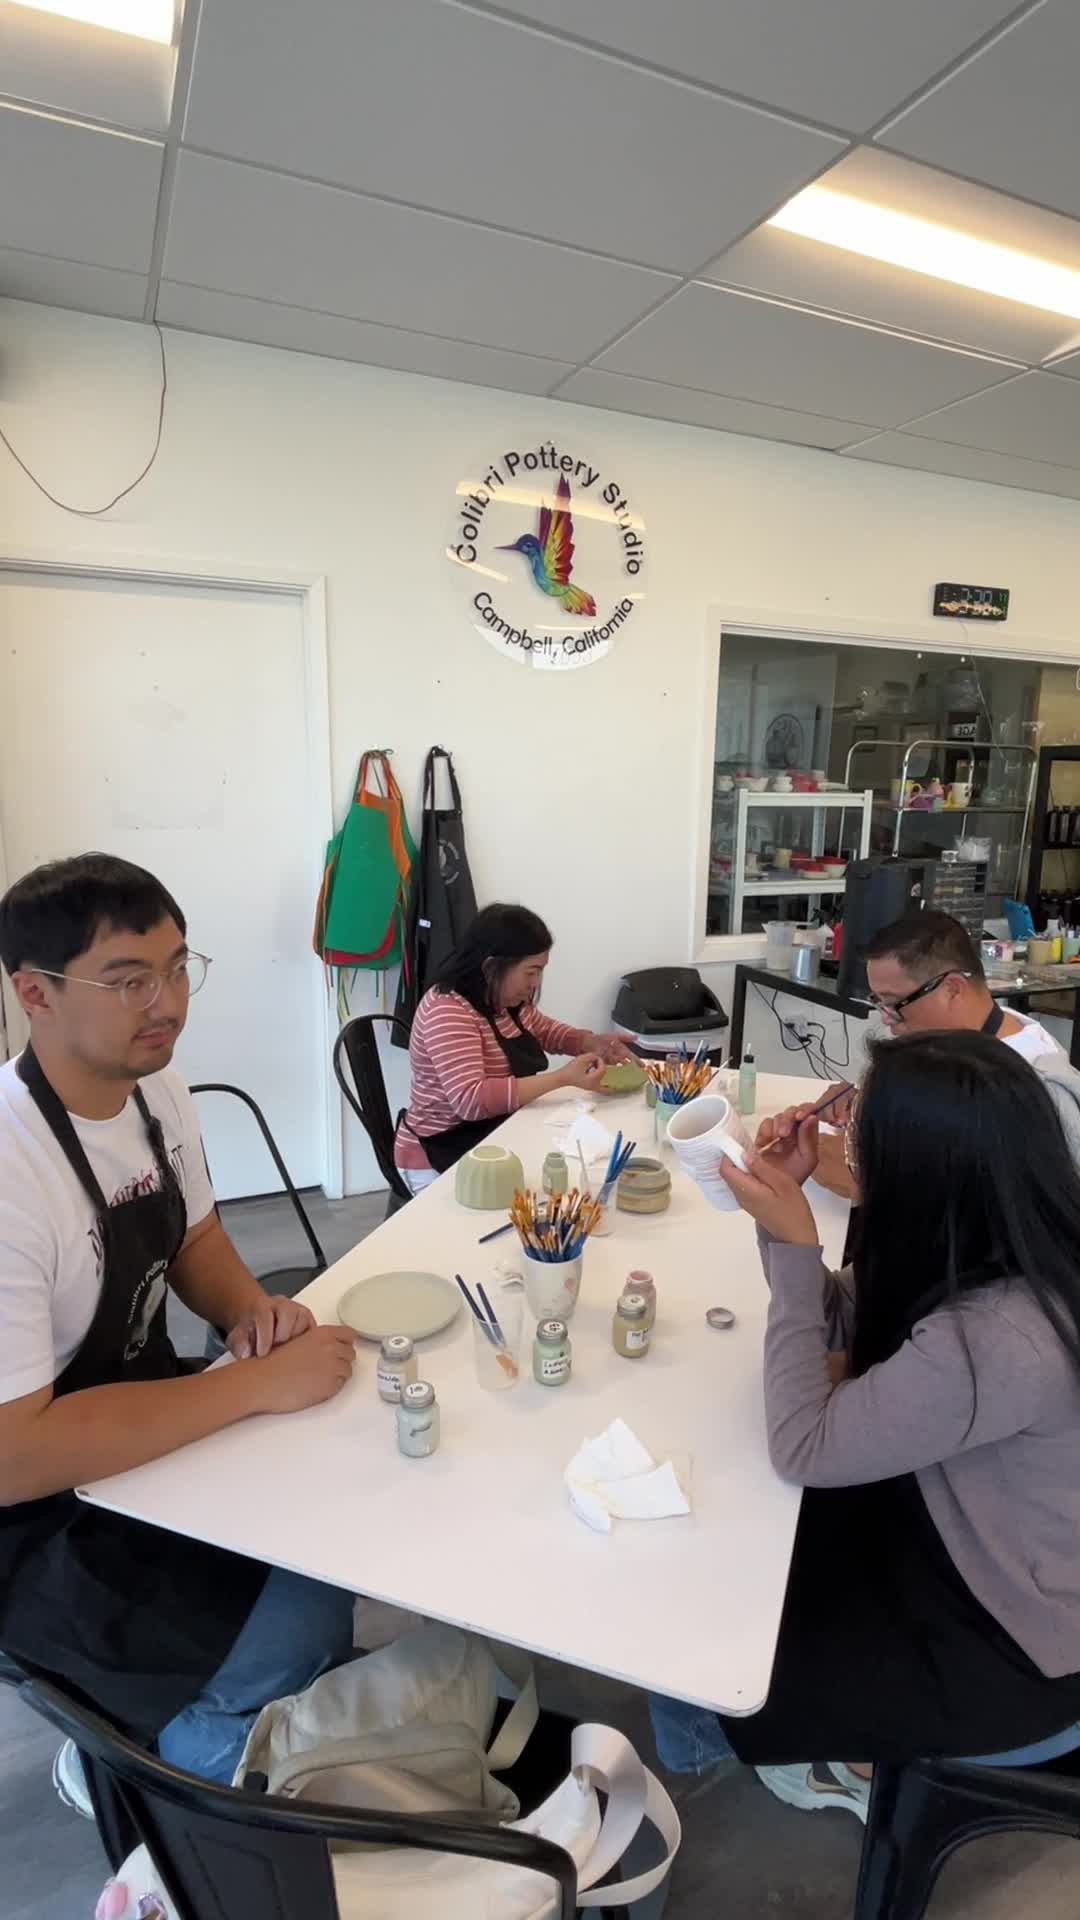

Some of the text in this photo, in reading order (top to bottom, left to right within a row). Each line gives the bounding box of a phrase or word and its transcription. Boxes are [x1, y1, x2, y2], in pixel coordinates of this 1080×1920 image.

[456, 446, 643, 575] Colibri Pottery Studio
[474, 592, 634, 657] Campbell, California
